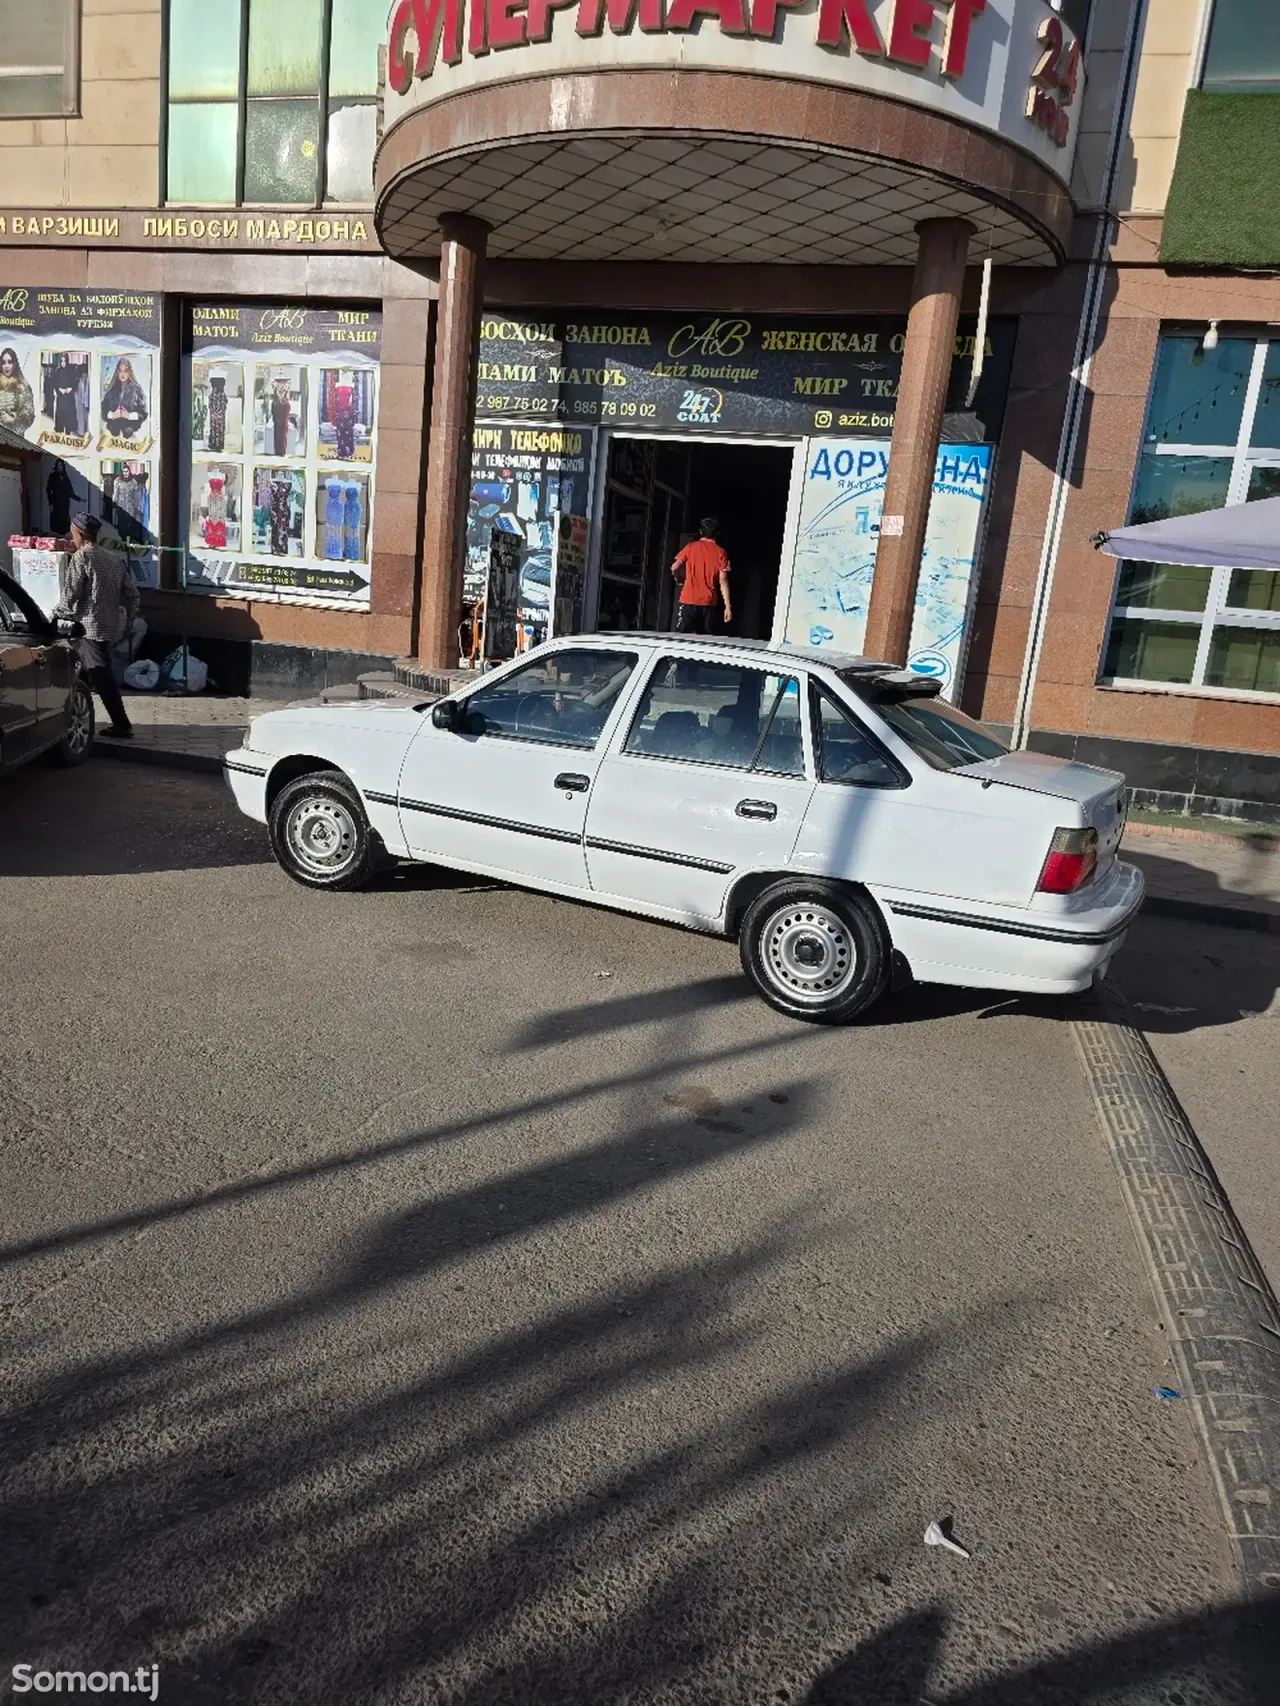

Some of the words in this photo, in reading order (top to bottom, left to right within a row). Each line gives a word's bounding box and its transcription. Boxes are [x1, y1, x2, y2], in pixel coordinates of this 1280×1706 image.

[12, 217, 119, 237] ВАРЗИШИ
[143, 218, 239, 238] ЛИБОСИ
[246, 219, 368, 243] МАРДОНА
[337, 312, 370, 325] МИР
[251, 333, 272, 343] Aziz
[274, 333, 314, 345] Boutique
[328, 329, 377, 343] ТКАНИ
[565, 325, 652, 346] ЗАНОНА
[761, 330, 878, 353] ЖЕНСКАЯ
[651, 361, 687, 378] Aziz
[689, 363, 759, 382] Boutique
[792, 376, 848, 396] МИР
[487, 396, 510, 410] 987
[514, 396, 530, 411] 75
[532, 397, 548, 412] 02
[574, 400, 597, 415] 985
[601, 402, 616, 416] 78
[620, 402, 637, 417] 09
[639, 403, 656, 417] 02
[44, 431, 85, 448] PARADISE
[110, 437, 140, 450] MAGIC
[810, 448, 982, 485] ДОРУНА
